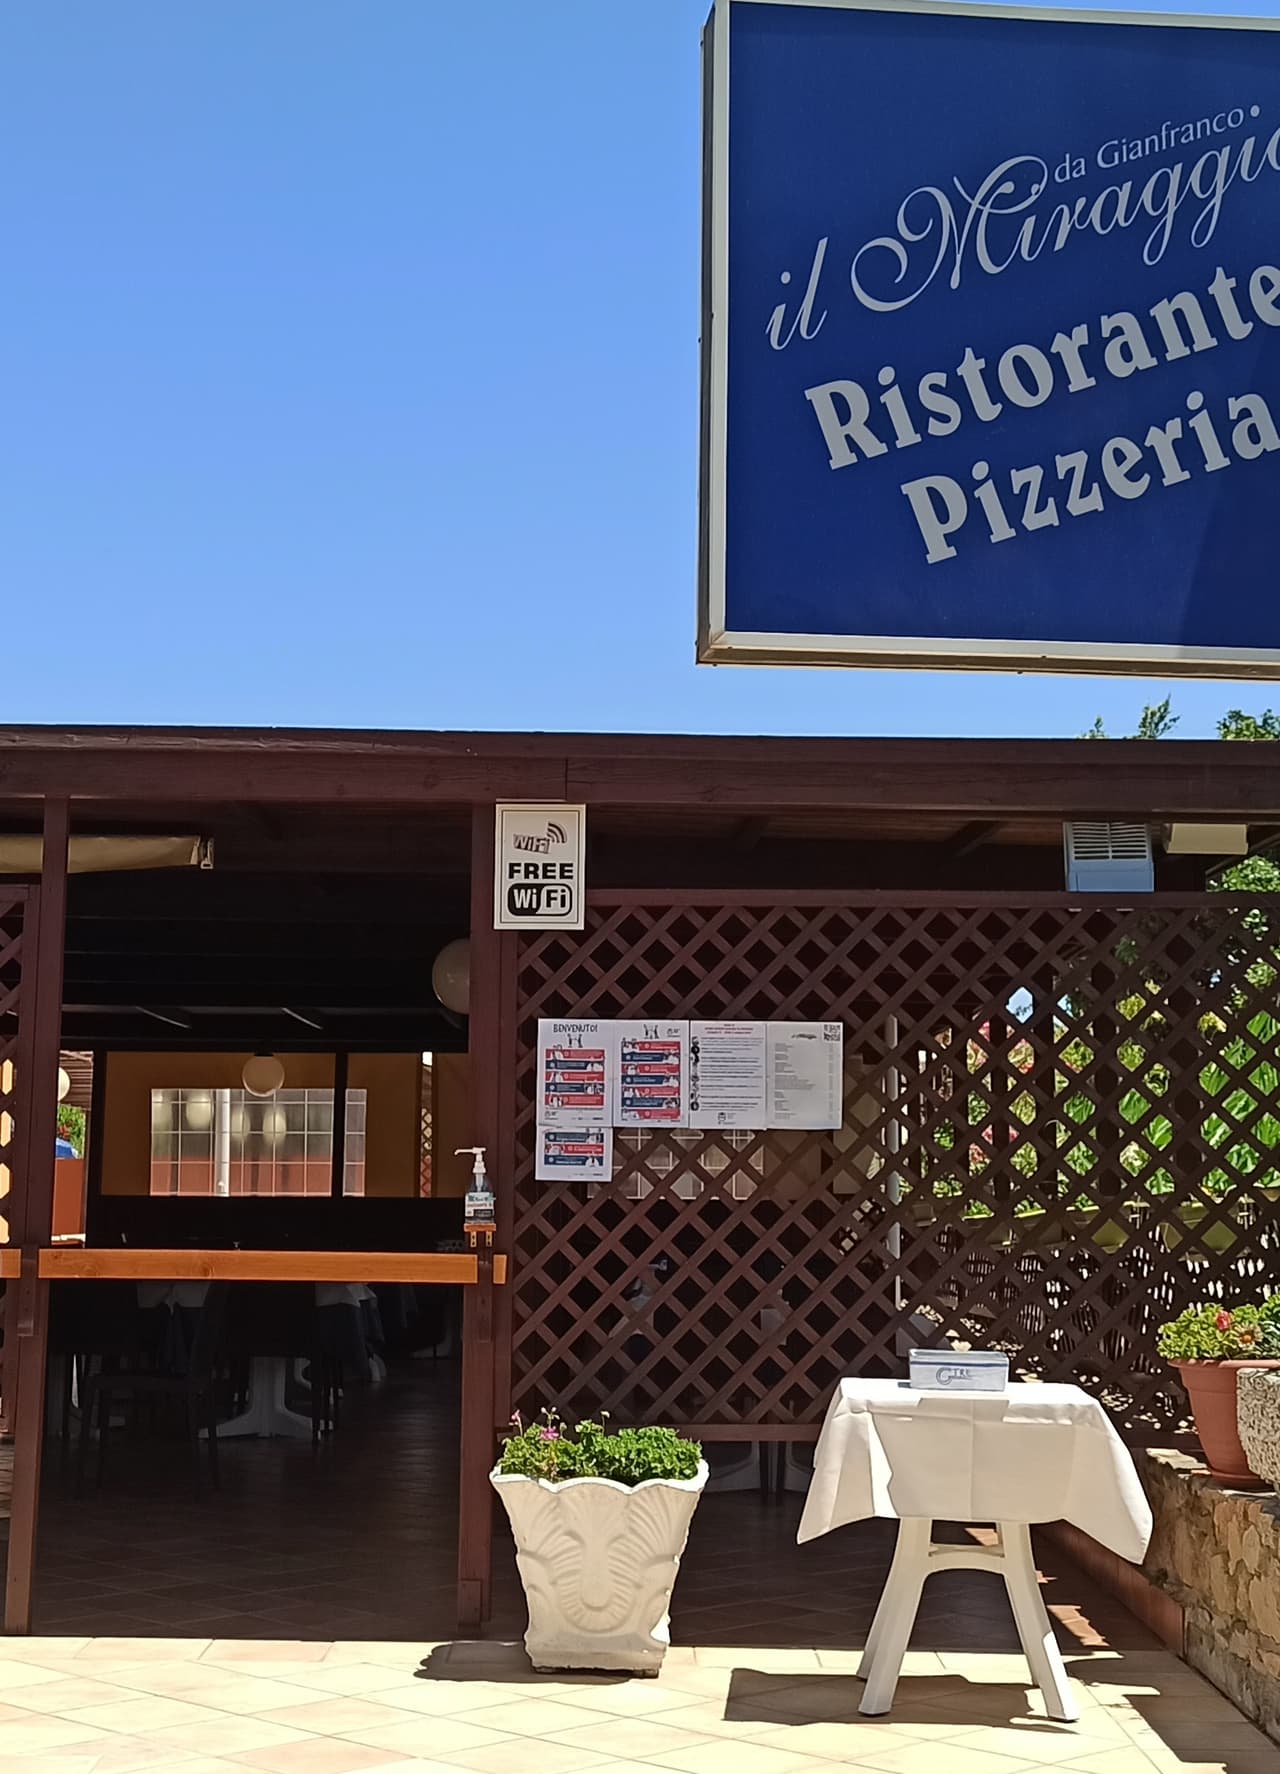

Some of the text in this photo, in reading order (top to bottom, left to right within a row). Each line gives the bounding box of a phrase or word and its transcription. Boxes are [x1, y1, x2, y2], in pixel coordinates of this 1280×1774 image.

[1053, 107, 1244, 183] da Gianfranco
[765, 237, 828, 350] il
[508, 862, 574, 880] FREE
